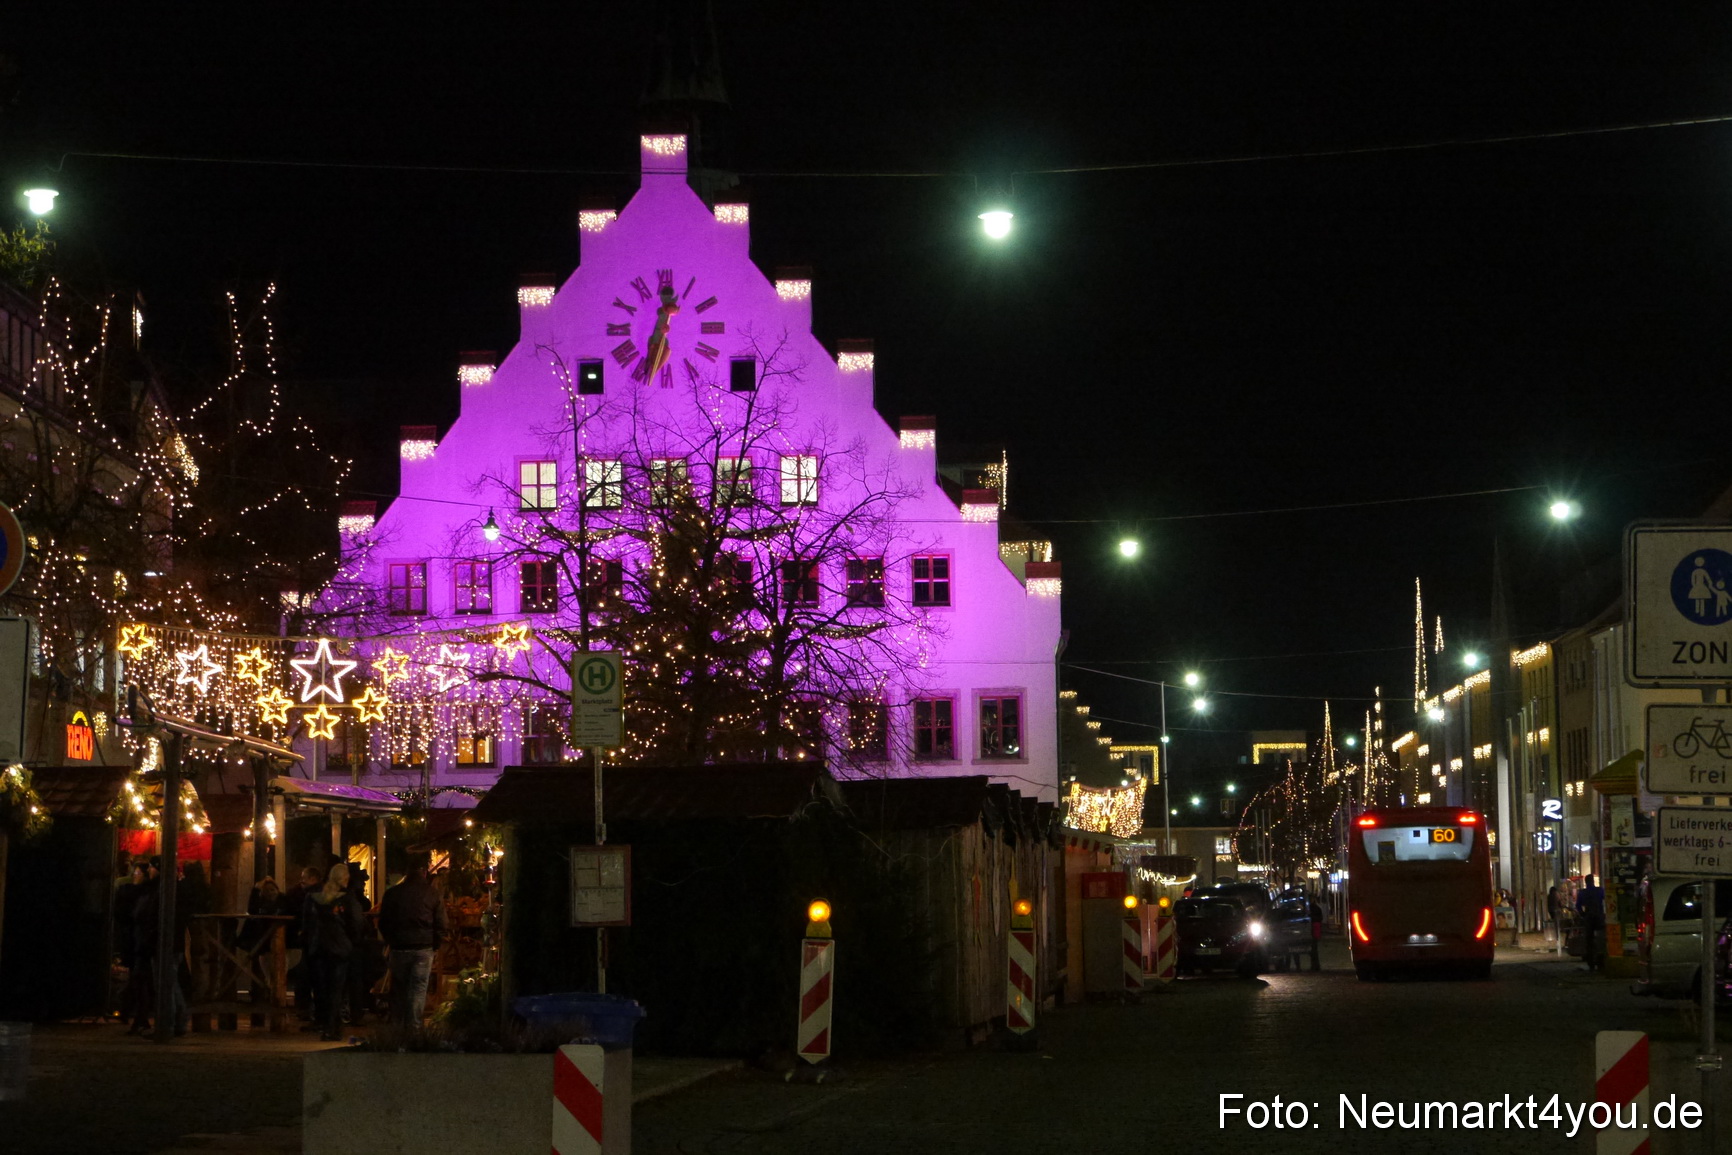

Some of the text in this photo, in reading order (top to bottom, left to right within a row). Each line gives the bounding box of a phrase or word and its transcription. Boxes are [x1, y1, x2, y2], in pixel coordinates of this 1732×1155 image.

[588, 666, 606, 687] H
[66, 723, 93, 761] RENO
[1689, 765, 1726, 784] frei
[1432, 828, 1455, 842] 60
[1664, 835, 1714, 851] werktags
[1695, 854, 1720, 866] frei
